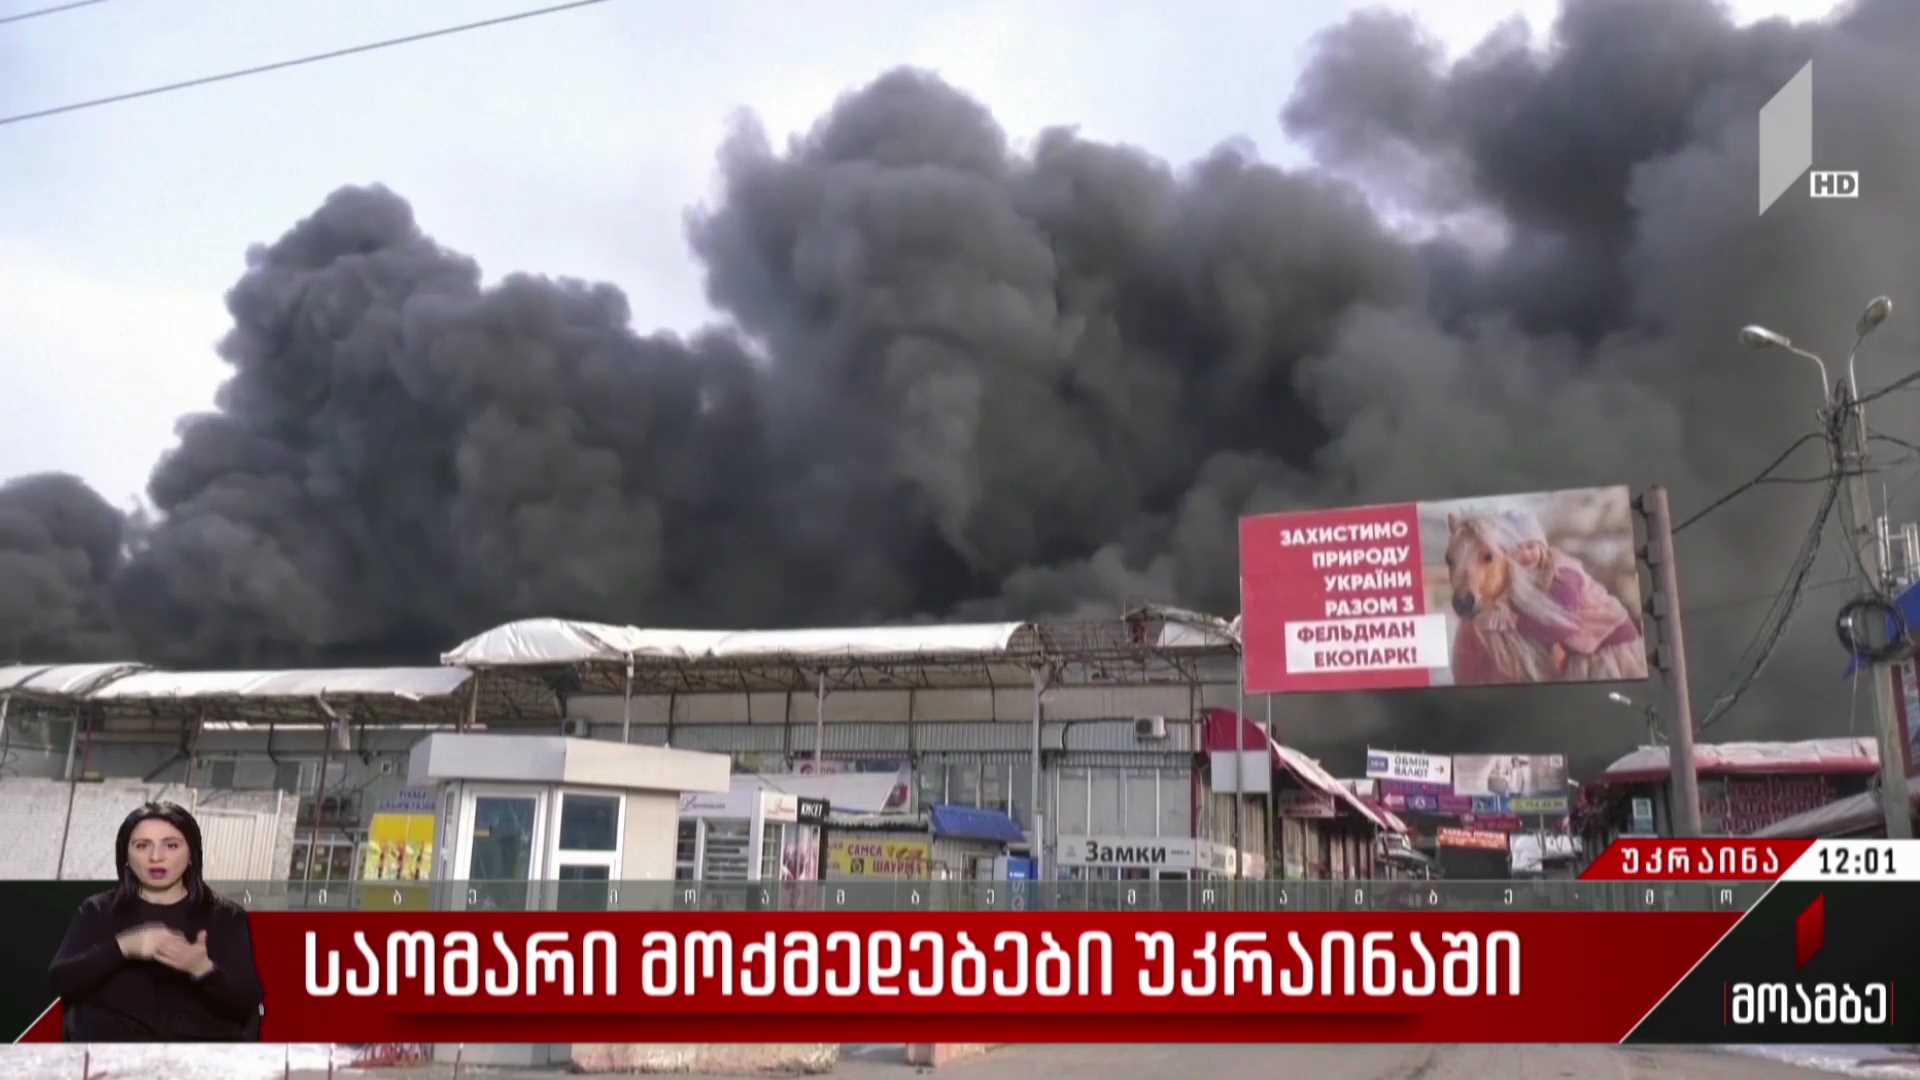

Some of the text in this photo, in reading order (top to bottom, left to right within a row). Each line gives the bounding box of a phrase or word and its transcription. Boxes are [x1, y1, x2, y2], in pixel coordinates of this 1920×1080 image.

[1280, 521, 1408, 546] ЗАХИСТИМО
[1312, 546, 1409, 568] ПРИРОДУ
[1324, 569, 1412, 592] УКРАЇНИ
[1325, 597, 1397, 617] РАЗОМ
[1297, 621, 1415, 643] ФЕЛЬДМАН
[1314, 647, 1417, 668] ЕКОПАРК!
[1394, 755, 1430, 769] ОБМІН
[847, 843, 883, 857] САМСА
[1085, 840, 1167, 863] Замки
